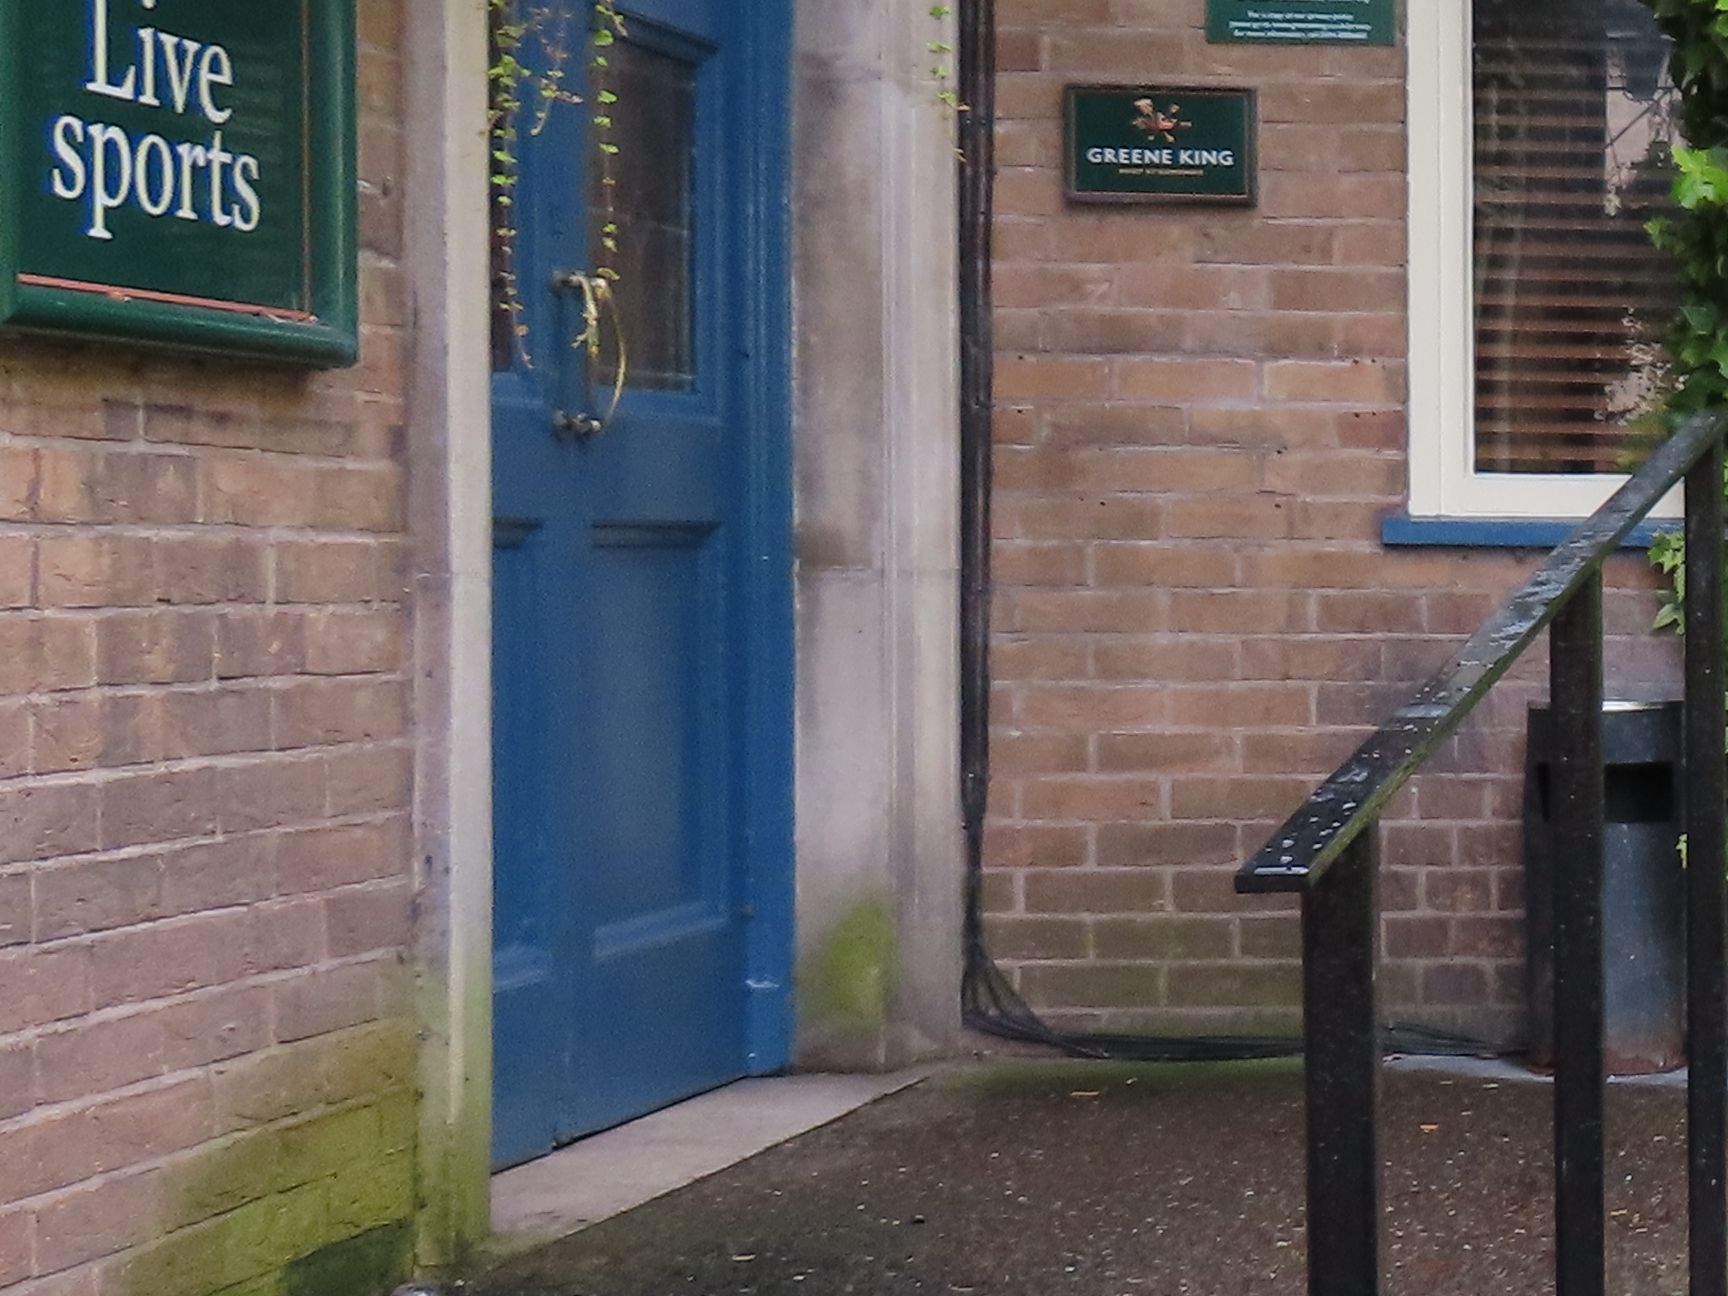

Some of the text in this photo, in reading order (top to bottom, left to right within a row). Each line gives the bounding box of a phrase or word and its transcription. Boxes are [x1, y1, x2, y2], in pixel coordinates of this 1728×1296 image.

[51, 115, 260, 240] sports
[1086, 147, 1235, 166] GREENE KING
